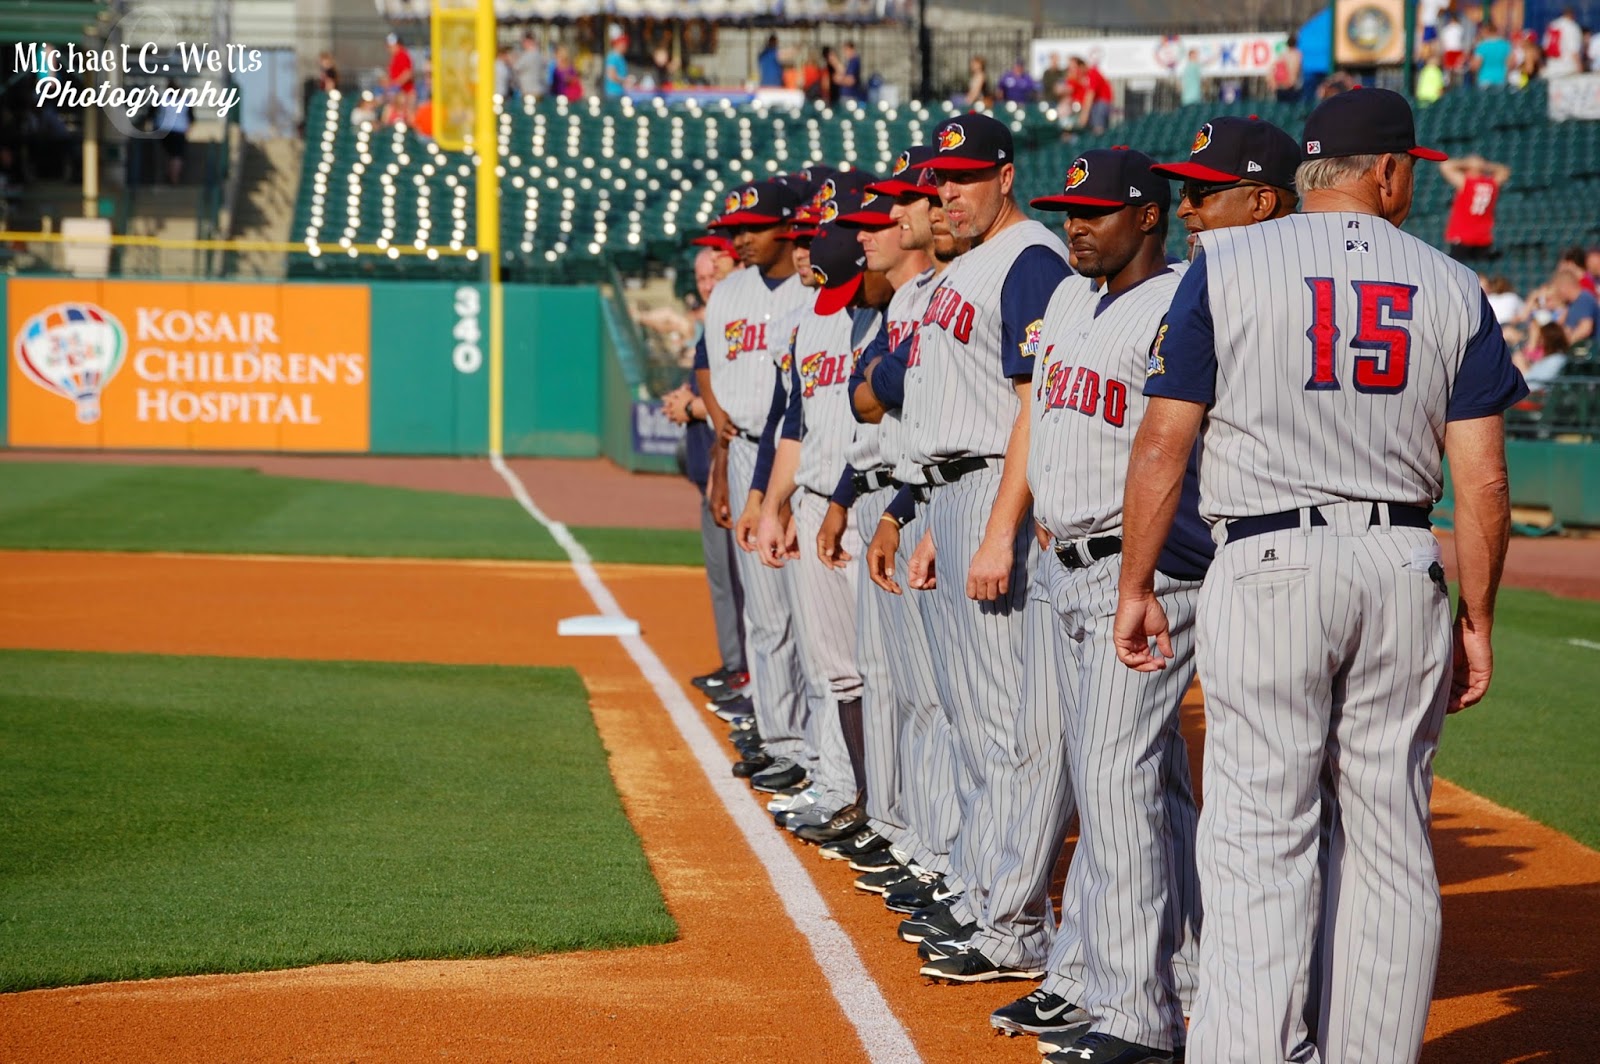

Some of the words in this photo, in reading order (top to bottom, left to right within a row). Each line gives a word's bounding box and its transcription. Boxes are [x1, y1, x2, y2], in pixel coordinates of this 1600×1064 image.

[135, 307, 279, 344] KOSAIR
[452, 286, 482, 374] 340
[1304, 276, 1418, 395] 15
[133, 347, 364, 385] CHILDREN'S
[136, 389, 321, 424] HOSPITAL
